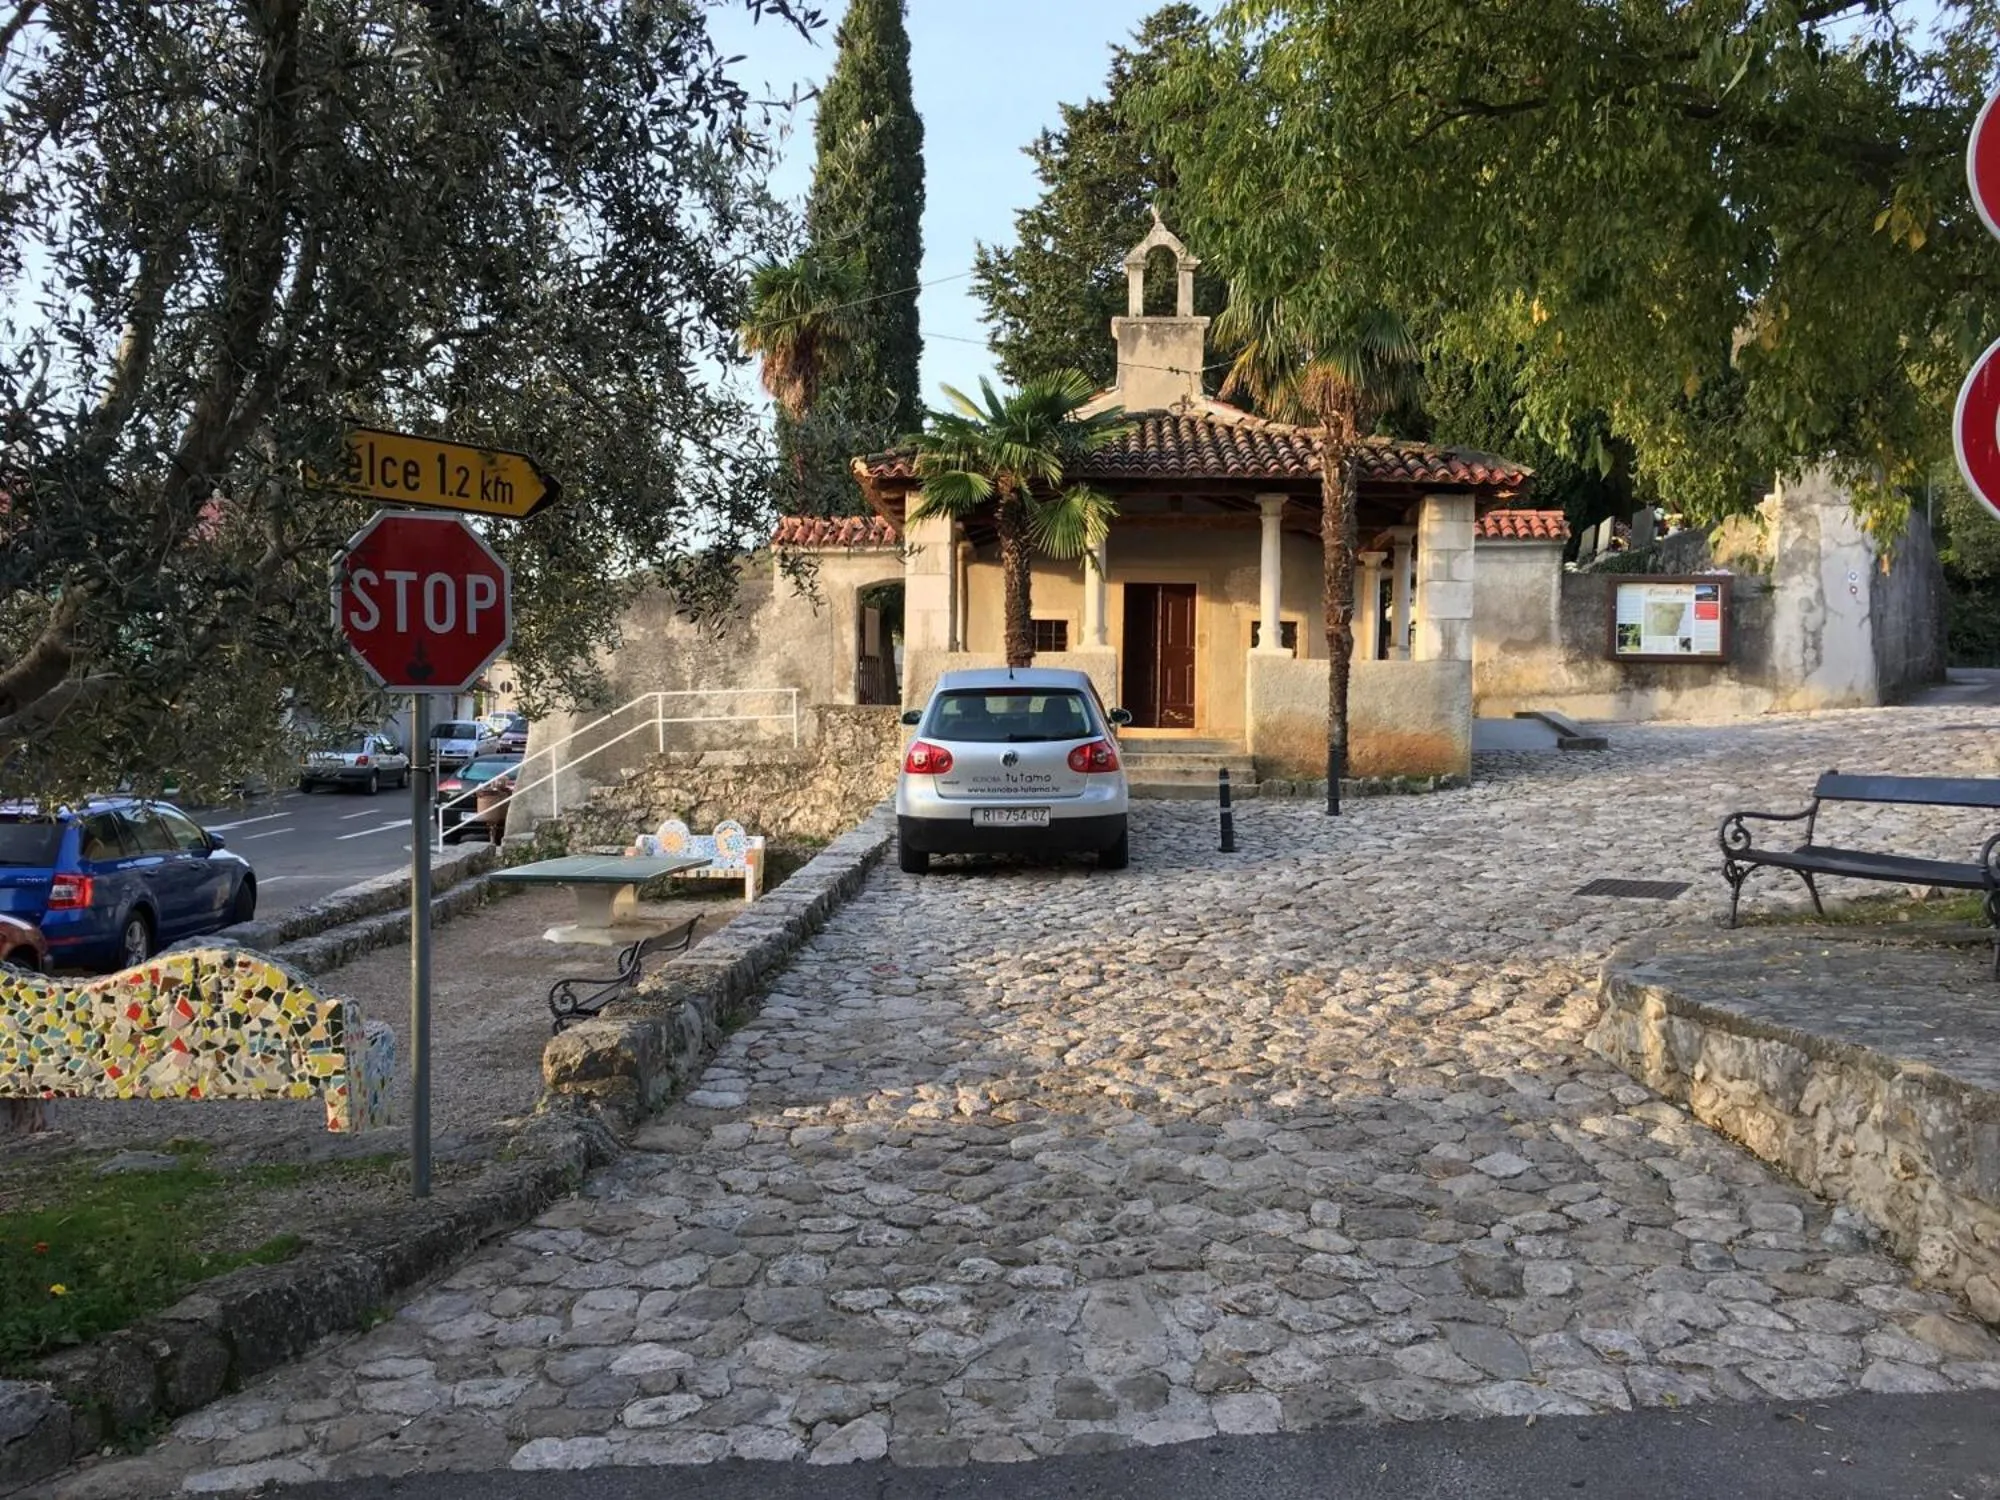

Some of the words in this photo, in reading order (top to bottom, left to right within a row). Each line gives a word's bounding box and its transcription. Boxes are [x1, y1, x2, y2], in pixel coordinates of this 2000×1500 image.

[437, 452, 470, 498] 1.2
[480, 470, 513, 504] km
[350, 567, 497, 634] STOP
[983, 809, 996, 822] RI
